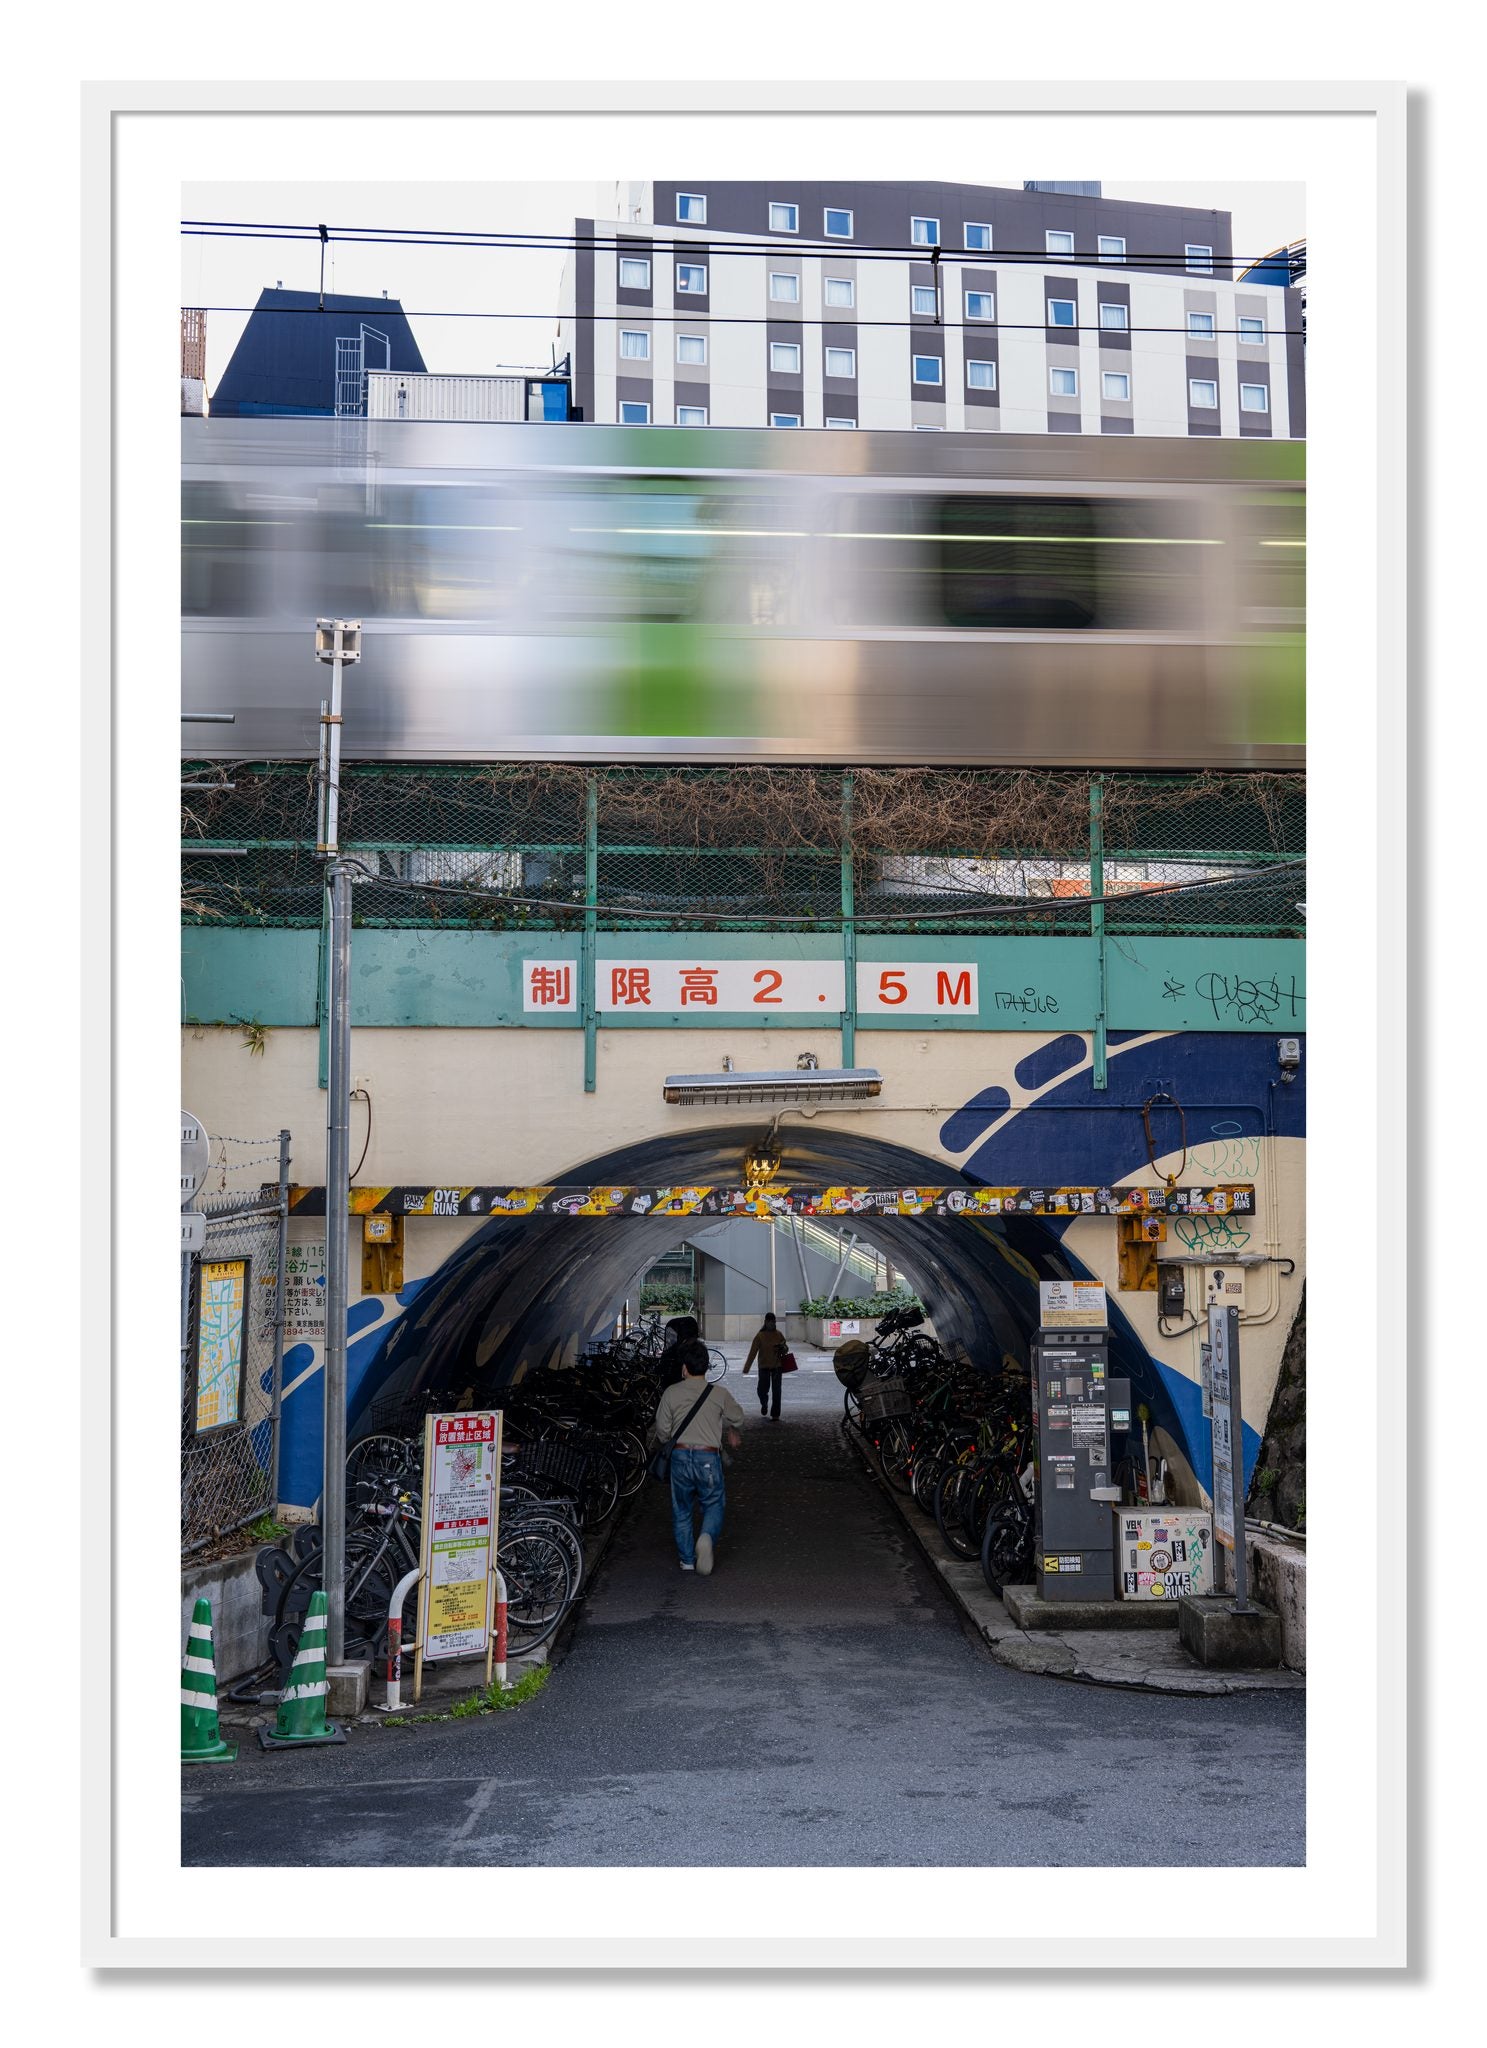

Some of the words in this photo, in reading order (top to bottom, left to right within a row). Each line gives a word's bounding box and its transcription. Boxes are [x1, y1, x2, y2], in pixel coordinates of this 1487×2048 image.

[434, 1189, 460, 1203] OYE
[1234, 1192, 1250, 1200] OYE
[432, 1203, 458, 1216] RUNS
[1234, 1200, 1250, 1209] RUNS
[439, 1430, 491, 1442] 放置禁止区域
[1164, 1573, 1190, 1586] OYE
[1165, 1586, 1191, 1599] RUNS
